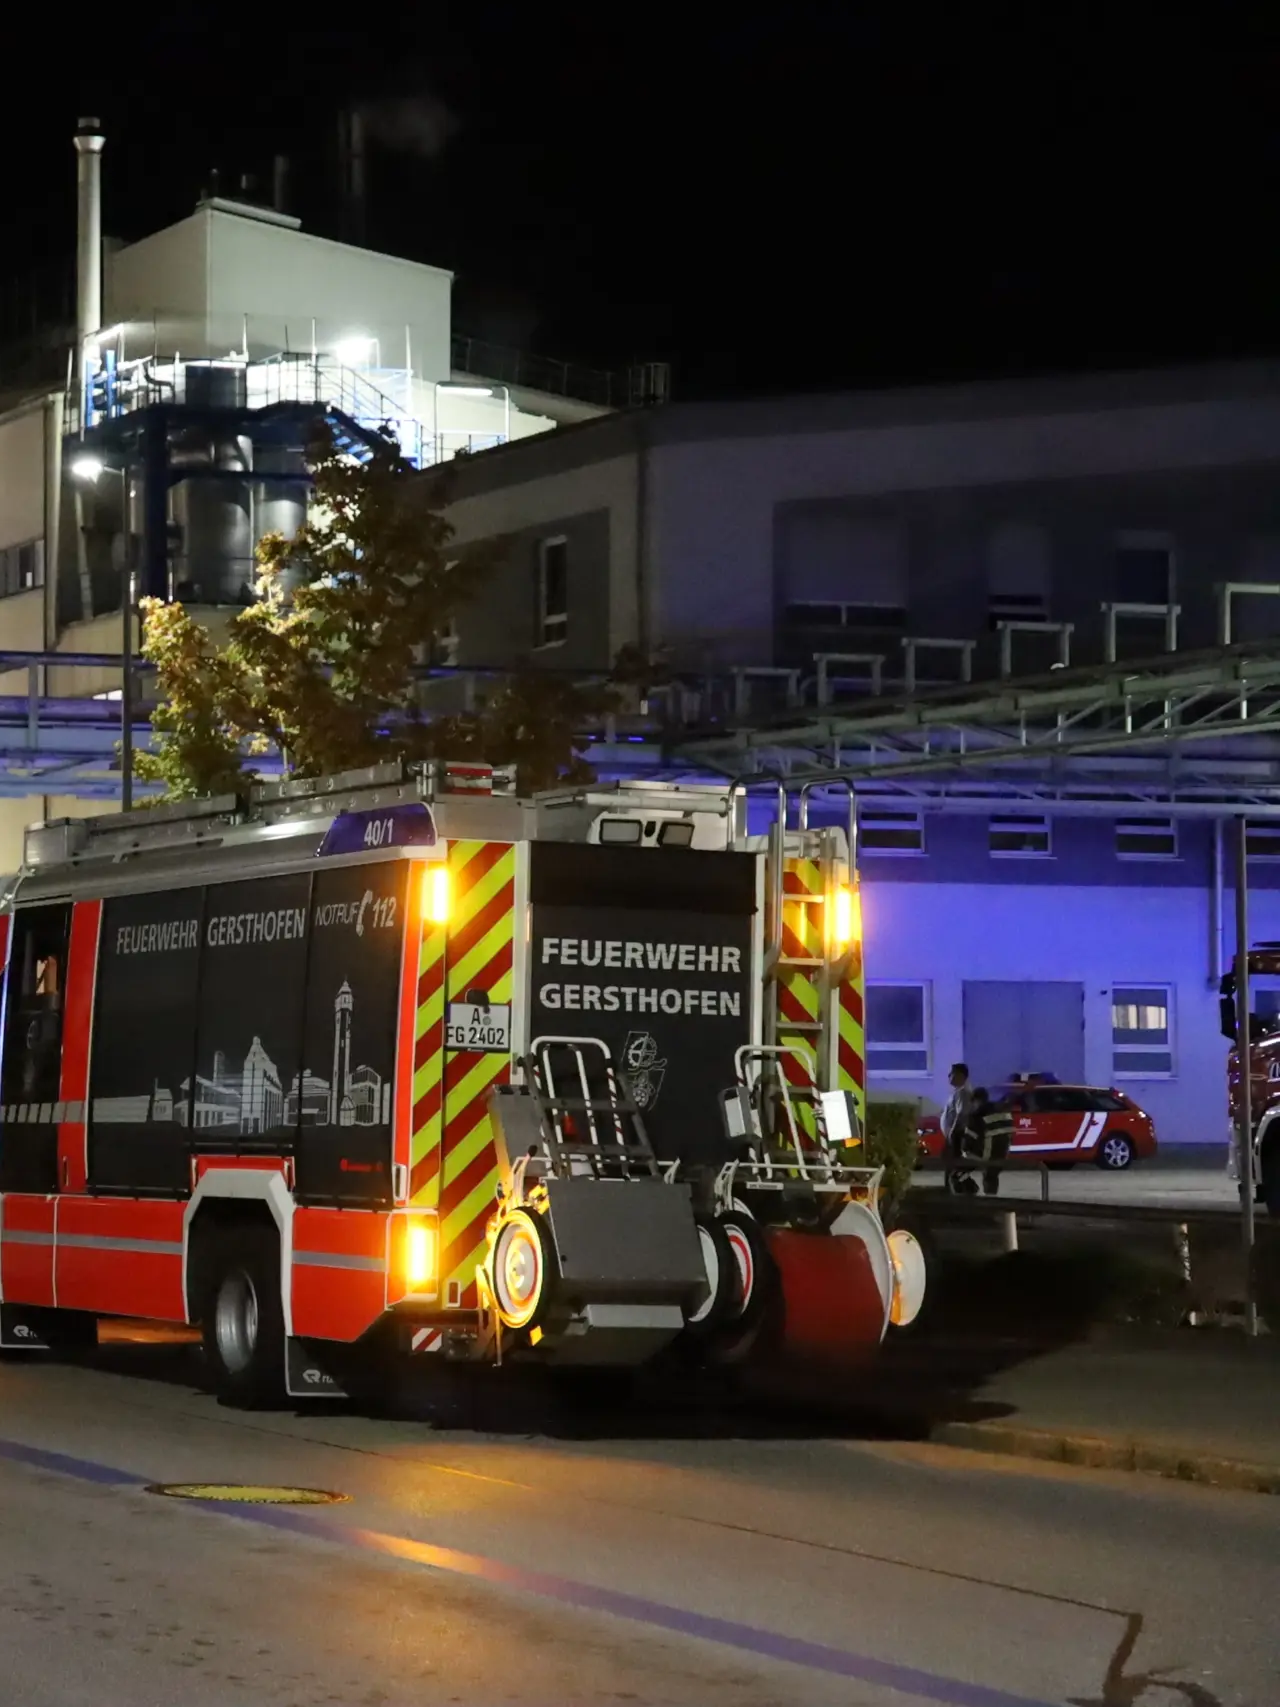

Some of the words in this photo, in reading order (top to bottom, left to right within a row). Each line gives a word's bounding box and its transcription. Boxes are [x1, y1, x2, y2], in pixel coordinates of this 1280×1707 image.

[363, 817, 394, 847] 40/1
[315, 901, 358, 927] NOTRUF
[372, 896, 398, 928] 112
[116, 919, 199, 956] FEUERWEHR
[207, 907, 307, 947] GERSTHOFEN
[541, 937, 741, 973] FEUERWEHR
[470, 1007, 481, 1025] A
[539, 983, 741, 1017] GERSTHOFEN
[445, 1026, 465, 1044] FG
[468, 1027, 505, 1046] 2402
